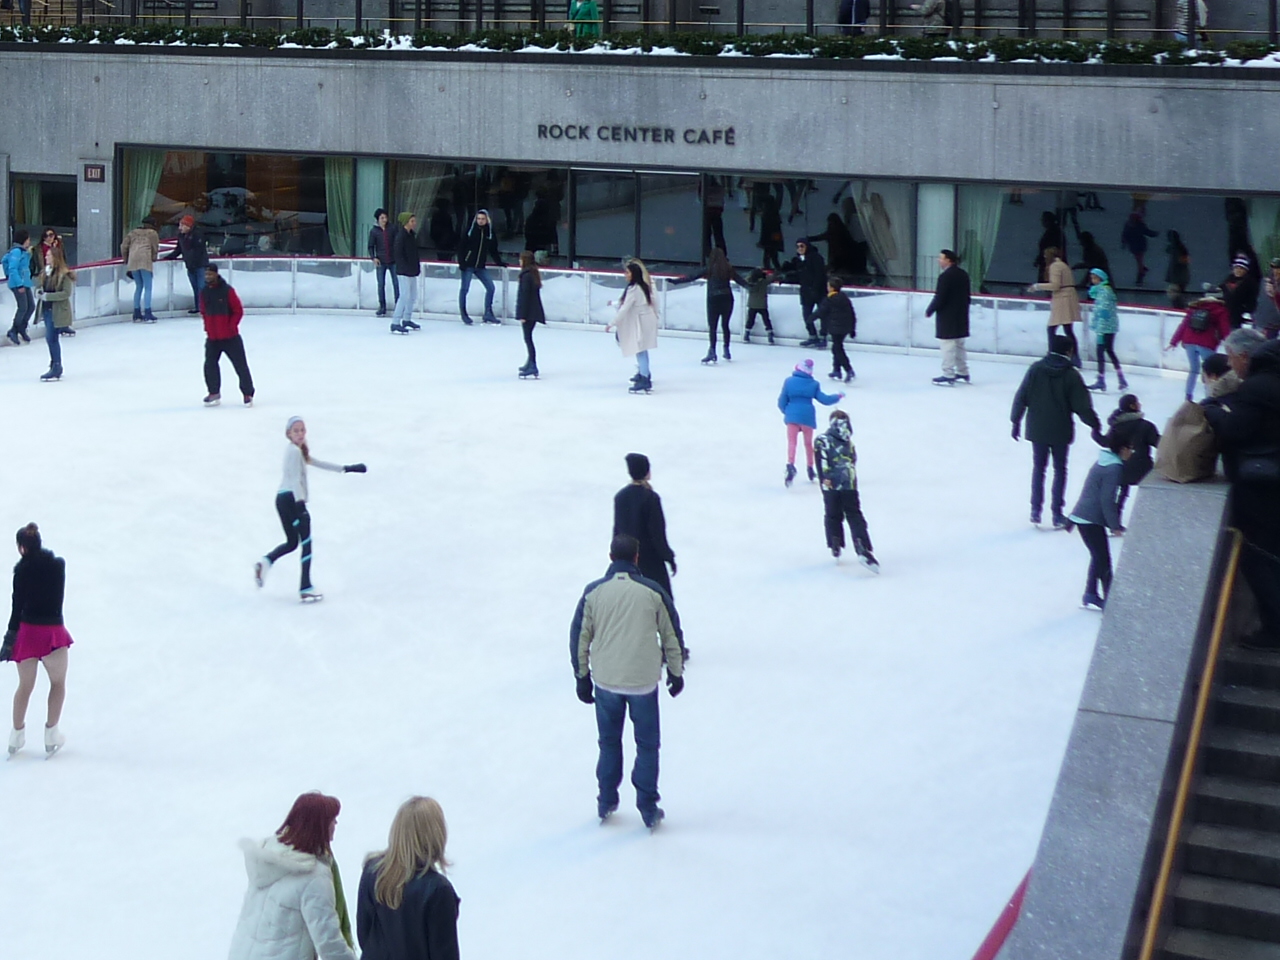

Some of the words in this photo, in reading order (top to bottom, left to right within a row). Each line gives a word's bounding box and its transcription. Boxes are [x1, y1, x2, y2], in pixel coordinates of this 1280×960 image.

[537, 124, 590, 140] ROCK
[597, 126, 675, 143] CENTER
[683, 126, 735, 146] CAFÉ
